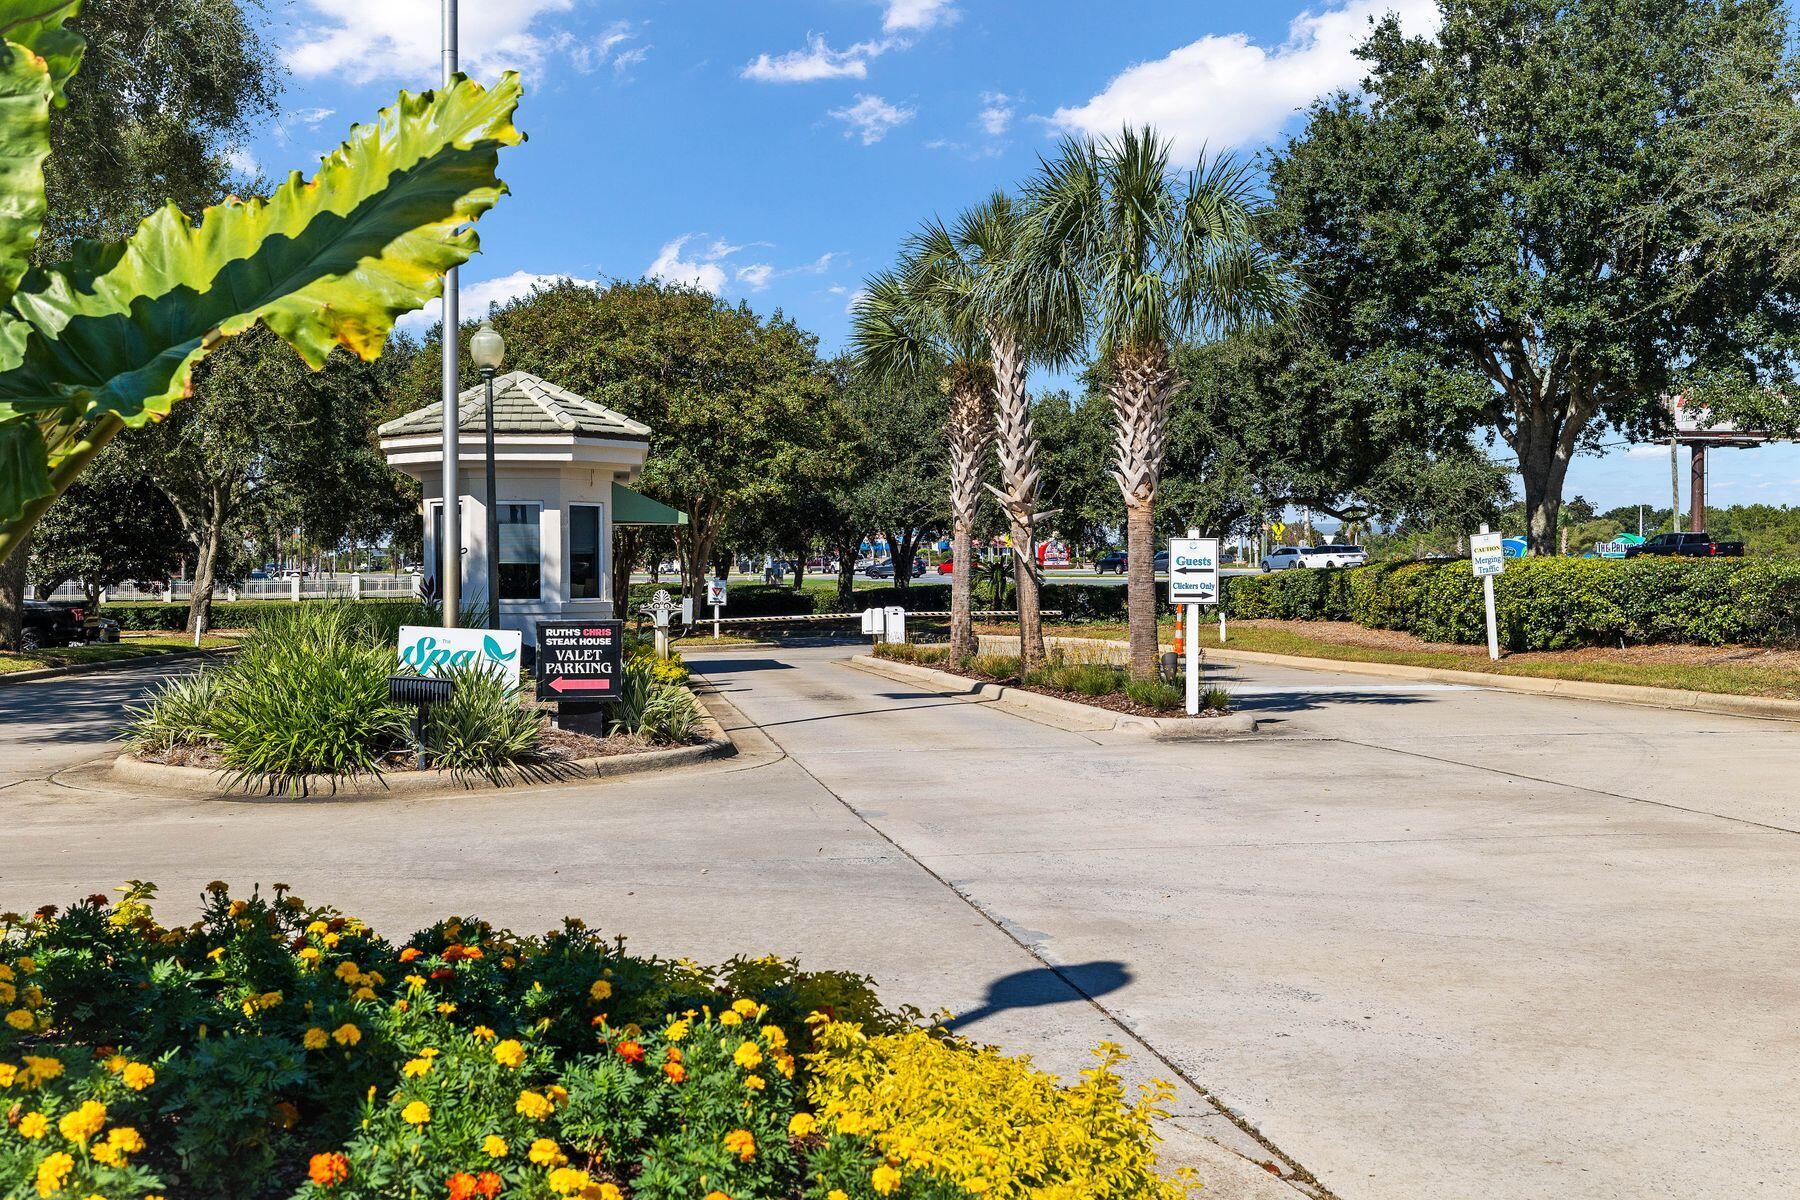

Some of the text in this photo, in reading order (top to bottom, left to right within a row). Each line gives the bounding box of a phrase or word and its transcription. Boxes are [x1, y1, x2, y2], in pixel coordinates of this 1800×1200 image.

[1474, 545, 1500, 553] CAUTION
[1176, 556, 1212, 566] Guests
[1475, 556, 1502, 565] Merging
[1478, 565, 1500, 573] Traffic
[1172, 582, 1215, 591] Clickers Only
[545, 628, 612, 637] RUTH'S CHRIS
[545, 637, 612, 646] STEAK HOUSE
[403, 636, 476, 675] Spa
[555, 649, 603, 661] VALET
[545, 662, 613, 674] PARKING
